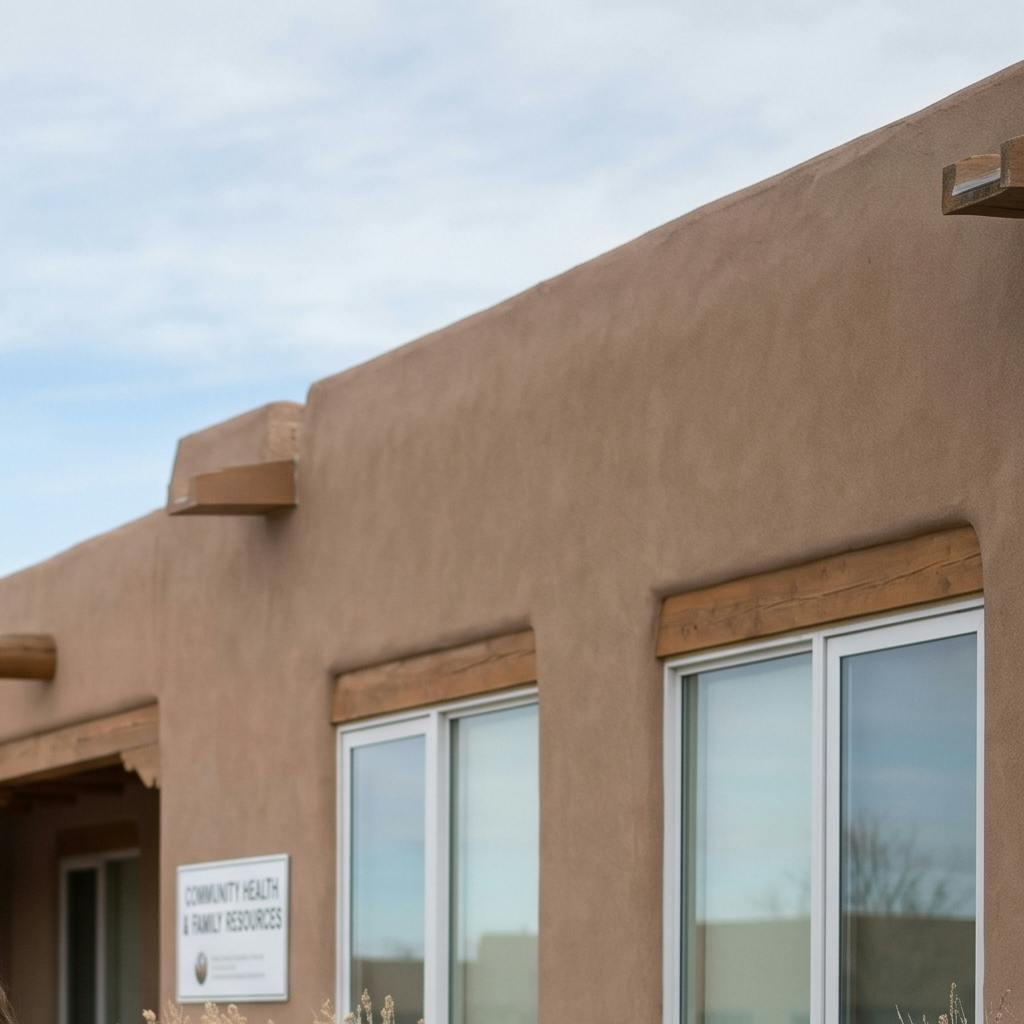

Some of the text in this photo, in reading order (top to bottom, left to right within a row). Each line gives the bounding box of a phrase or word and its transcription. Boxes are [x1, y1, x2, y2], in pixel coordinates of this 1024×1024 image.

[185, 877, 279, 906] COMMUNITY HEALTH
[192, 912, 222, 934] FAMILY
[226, 907, 282, 932] RESOURCES
